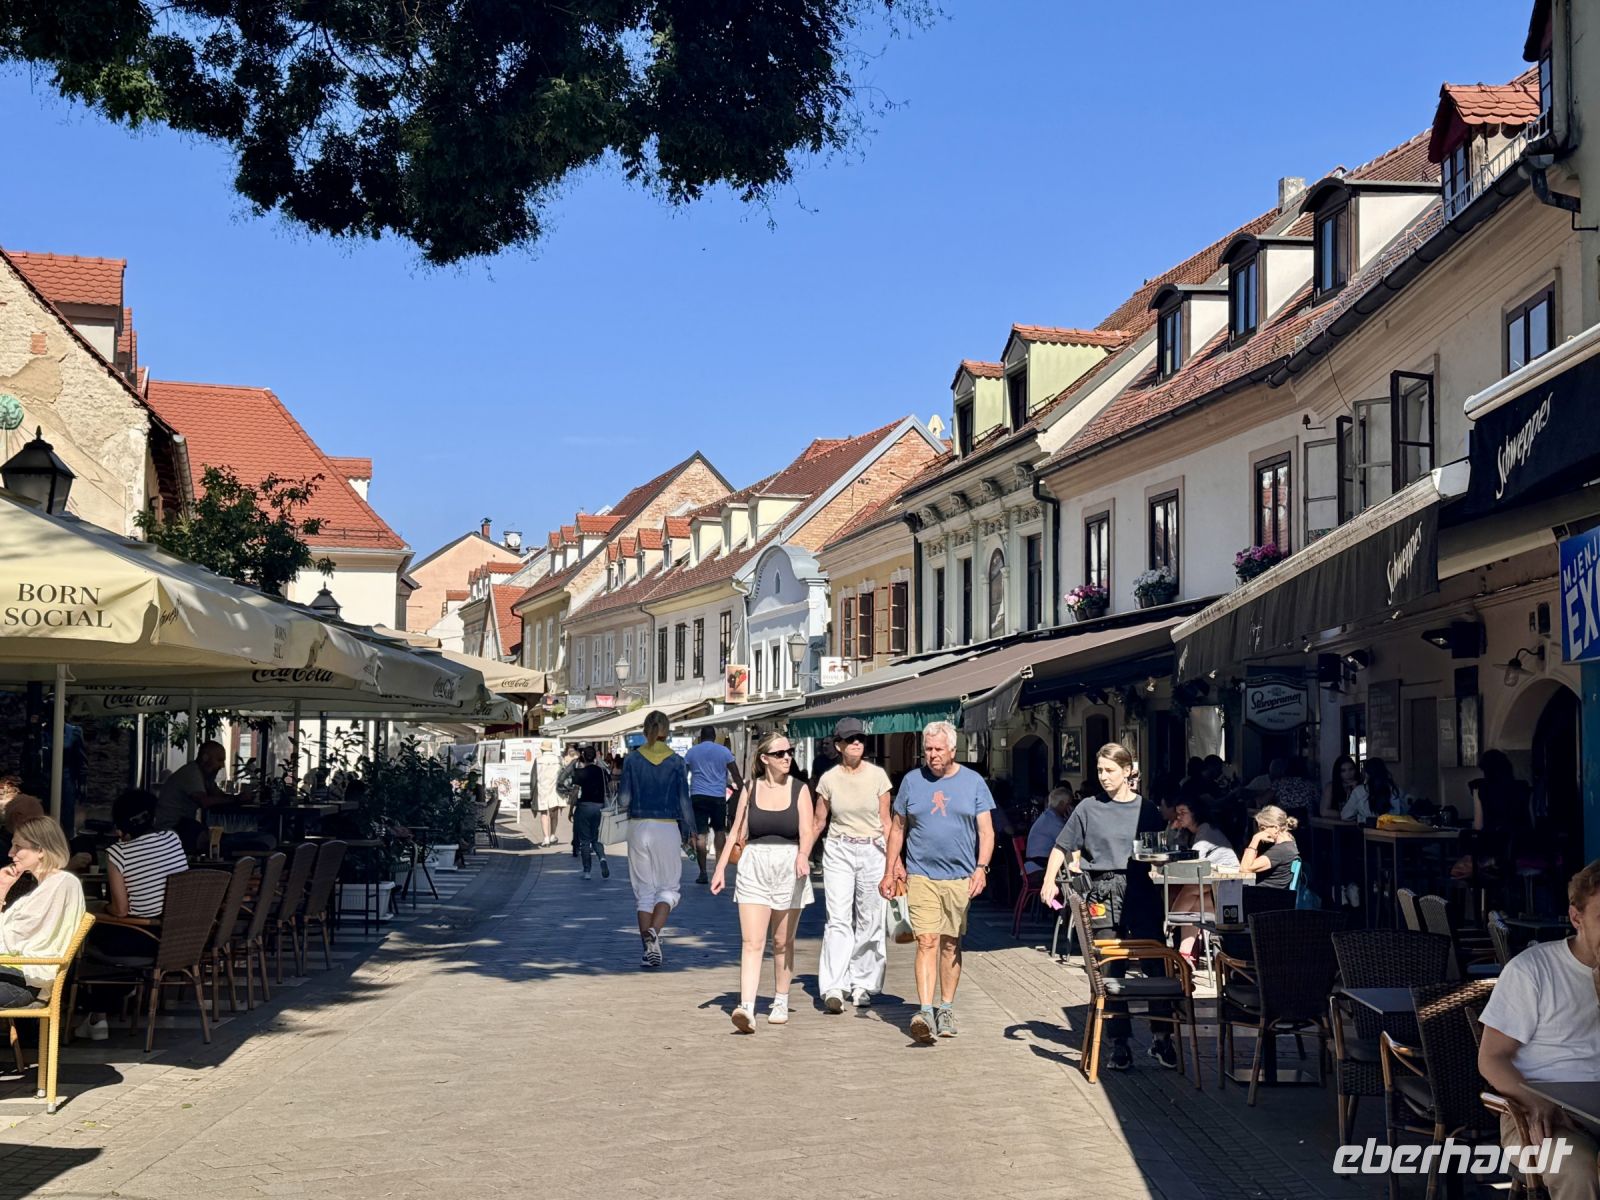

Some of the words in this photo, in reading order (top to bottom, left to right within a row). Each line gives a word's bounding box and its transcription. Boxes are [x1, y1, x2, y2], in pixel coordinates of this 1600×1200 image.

[1495, 391, 1554, 500] Schweppes
[1563, 535, 1600, 593] MJENJ
[3, 606, 113, 629] SOCIAL
[17, 582, 102, 605] BORN
[1565, 556, 1600, 661] EX
